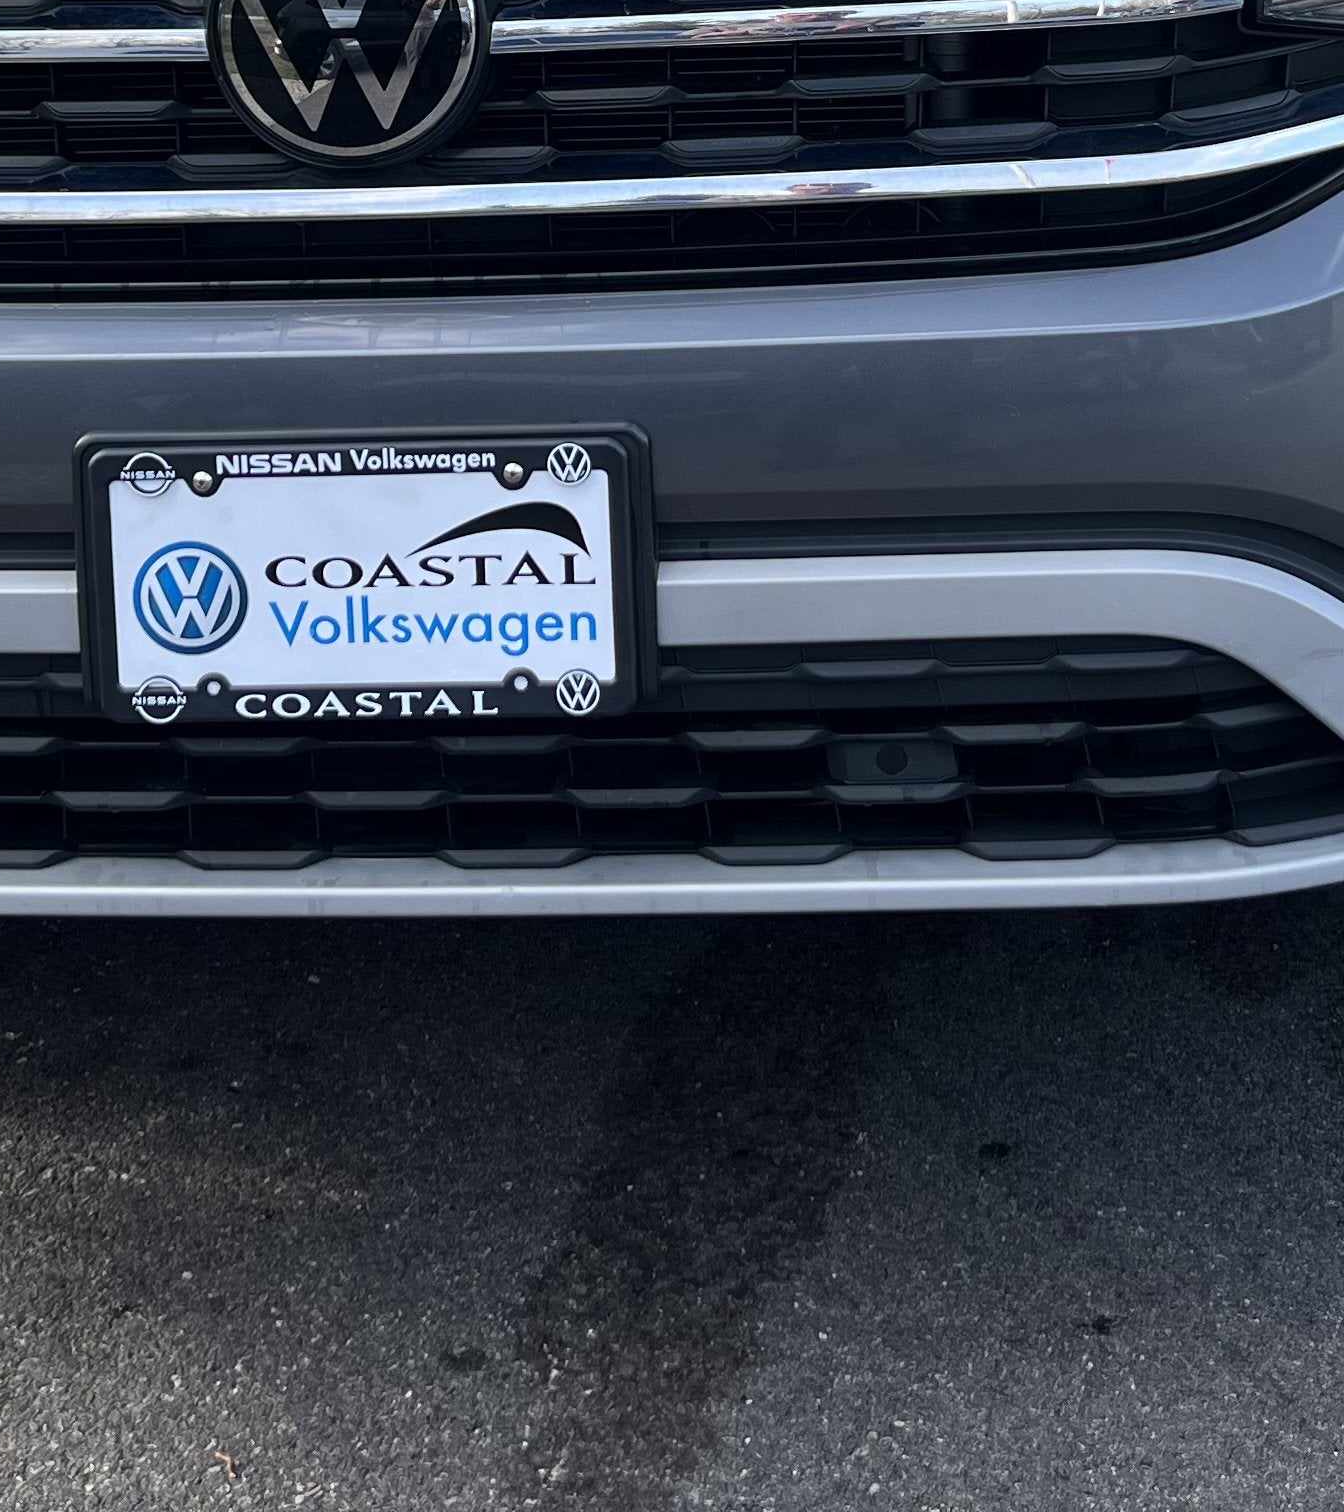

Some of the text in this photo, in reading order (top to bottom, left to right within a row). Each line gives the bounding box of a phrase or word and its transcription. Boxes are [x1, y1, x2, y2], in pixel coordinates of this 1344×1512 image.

[120, 468, 176, 480] NISSAN
[216, 448, 496, 475] NISSAN Volkswagen
[265, 550, 596, 589] COASTAL
[269, 594, 597, 656] Volkswagen
[132, 694, 187, 706] NISSAN
[234, 689, 499, 719] COASTAL
